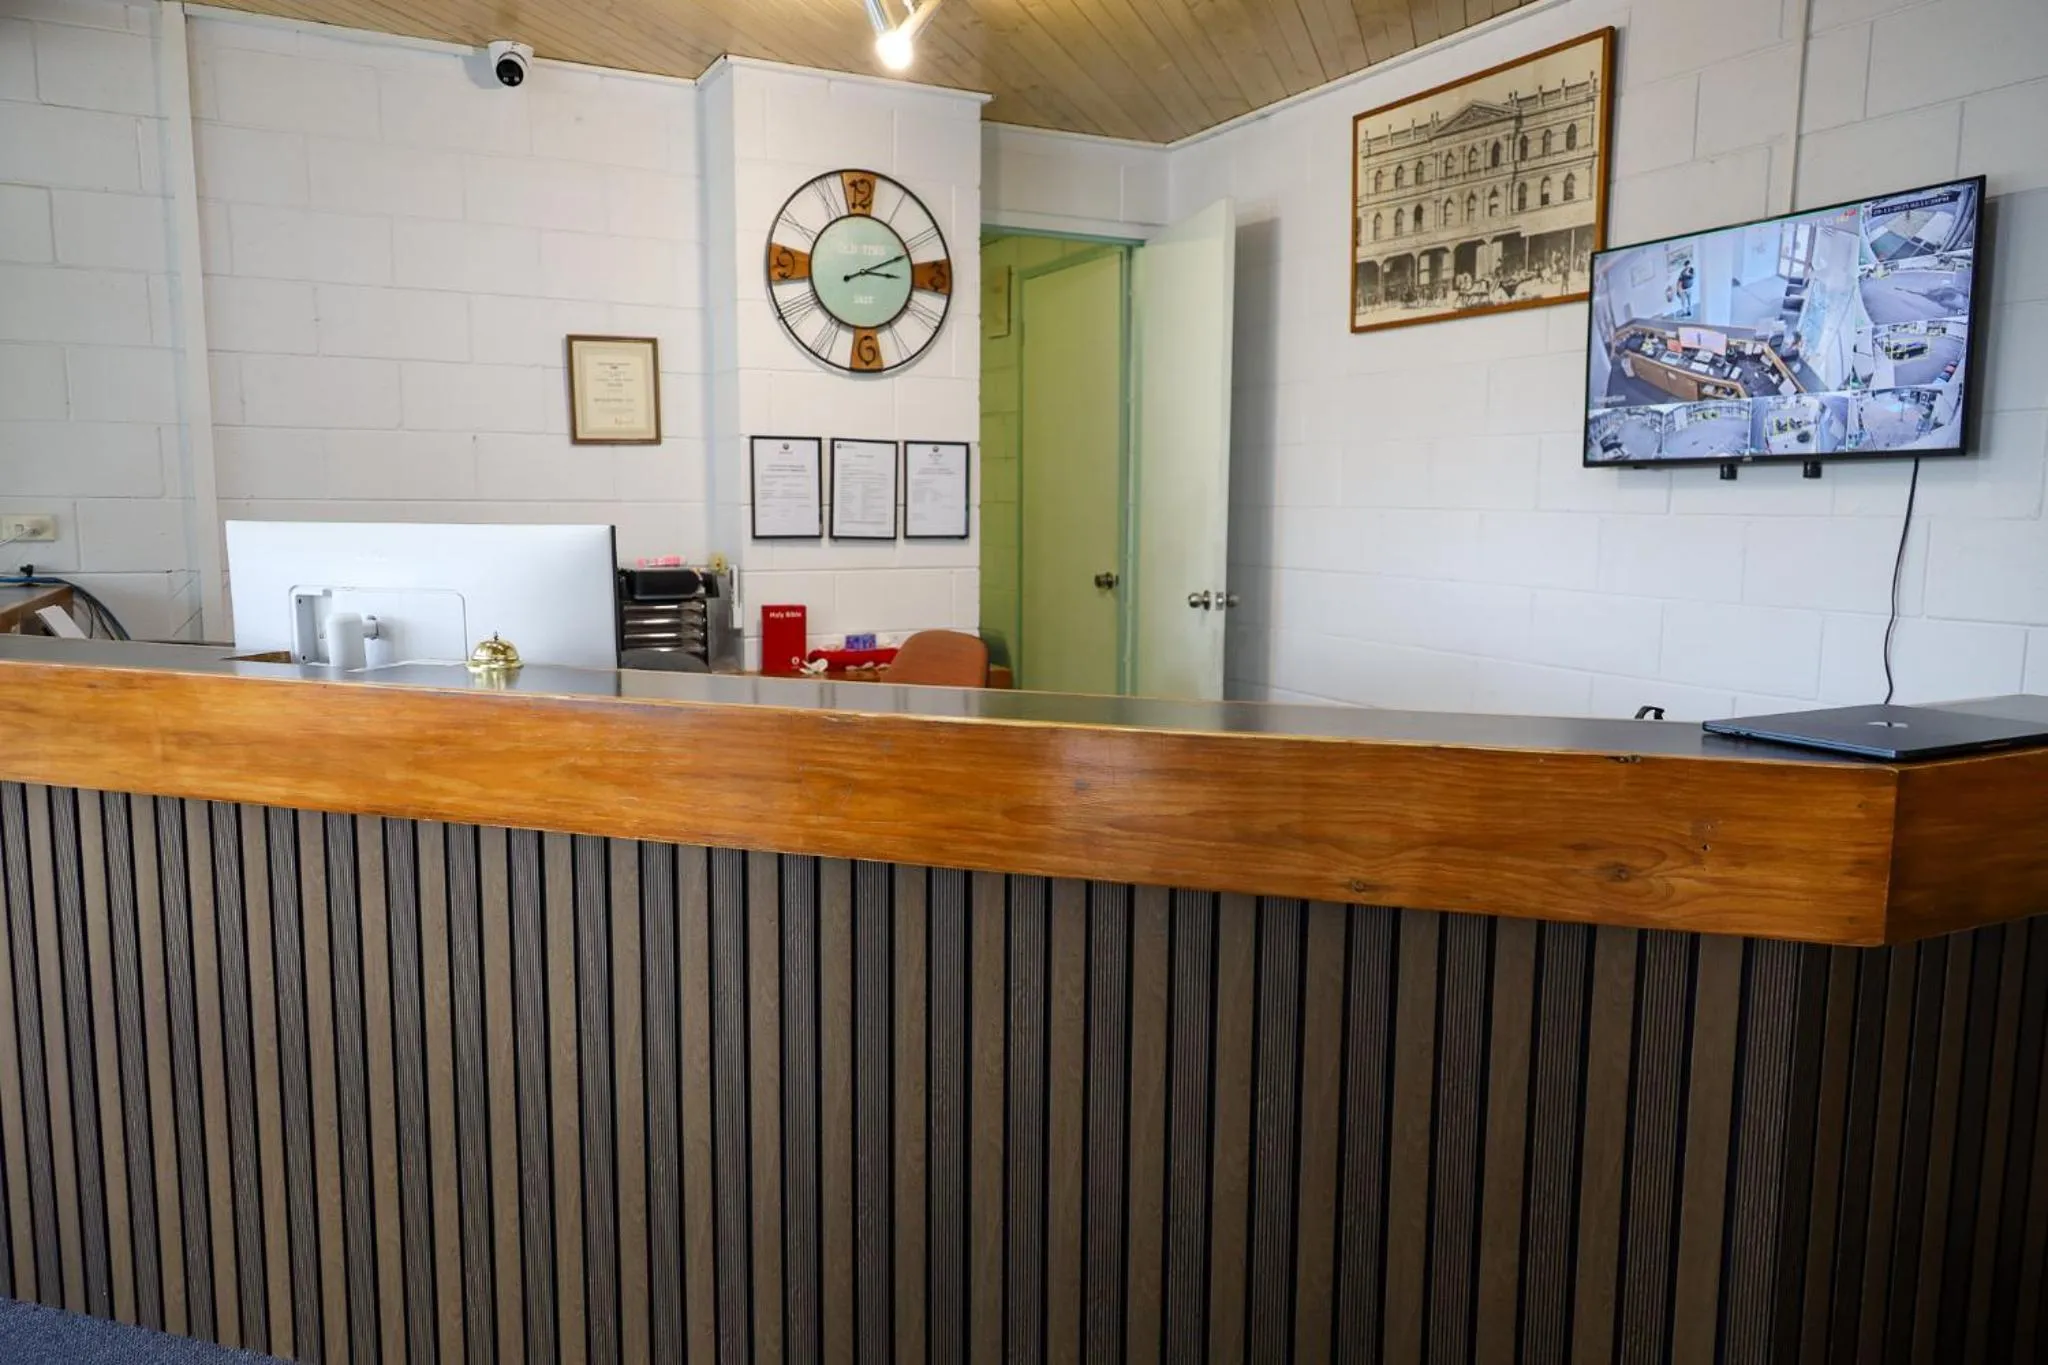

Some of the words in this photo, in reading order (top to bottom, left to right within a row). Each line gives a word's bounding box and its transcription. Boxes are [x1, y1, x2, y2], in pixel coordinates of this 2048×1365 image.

[849, 177, 872, 210] 12
[776, 246, 797, 280] 9
[928, 261, 949, 291] 3
[856, 334, 876, 367] 6
[769, 611, 784, 619] Holy
[785, 610, 802, 618] Bible
